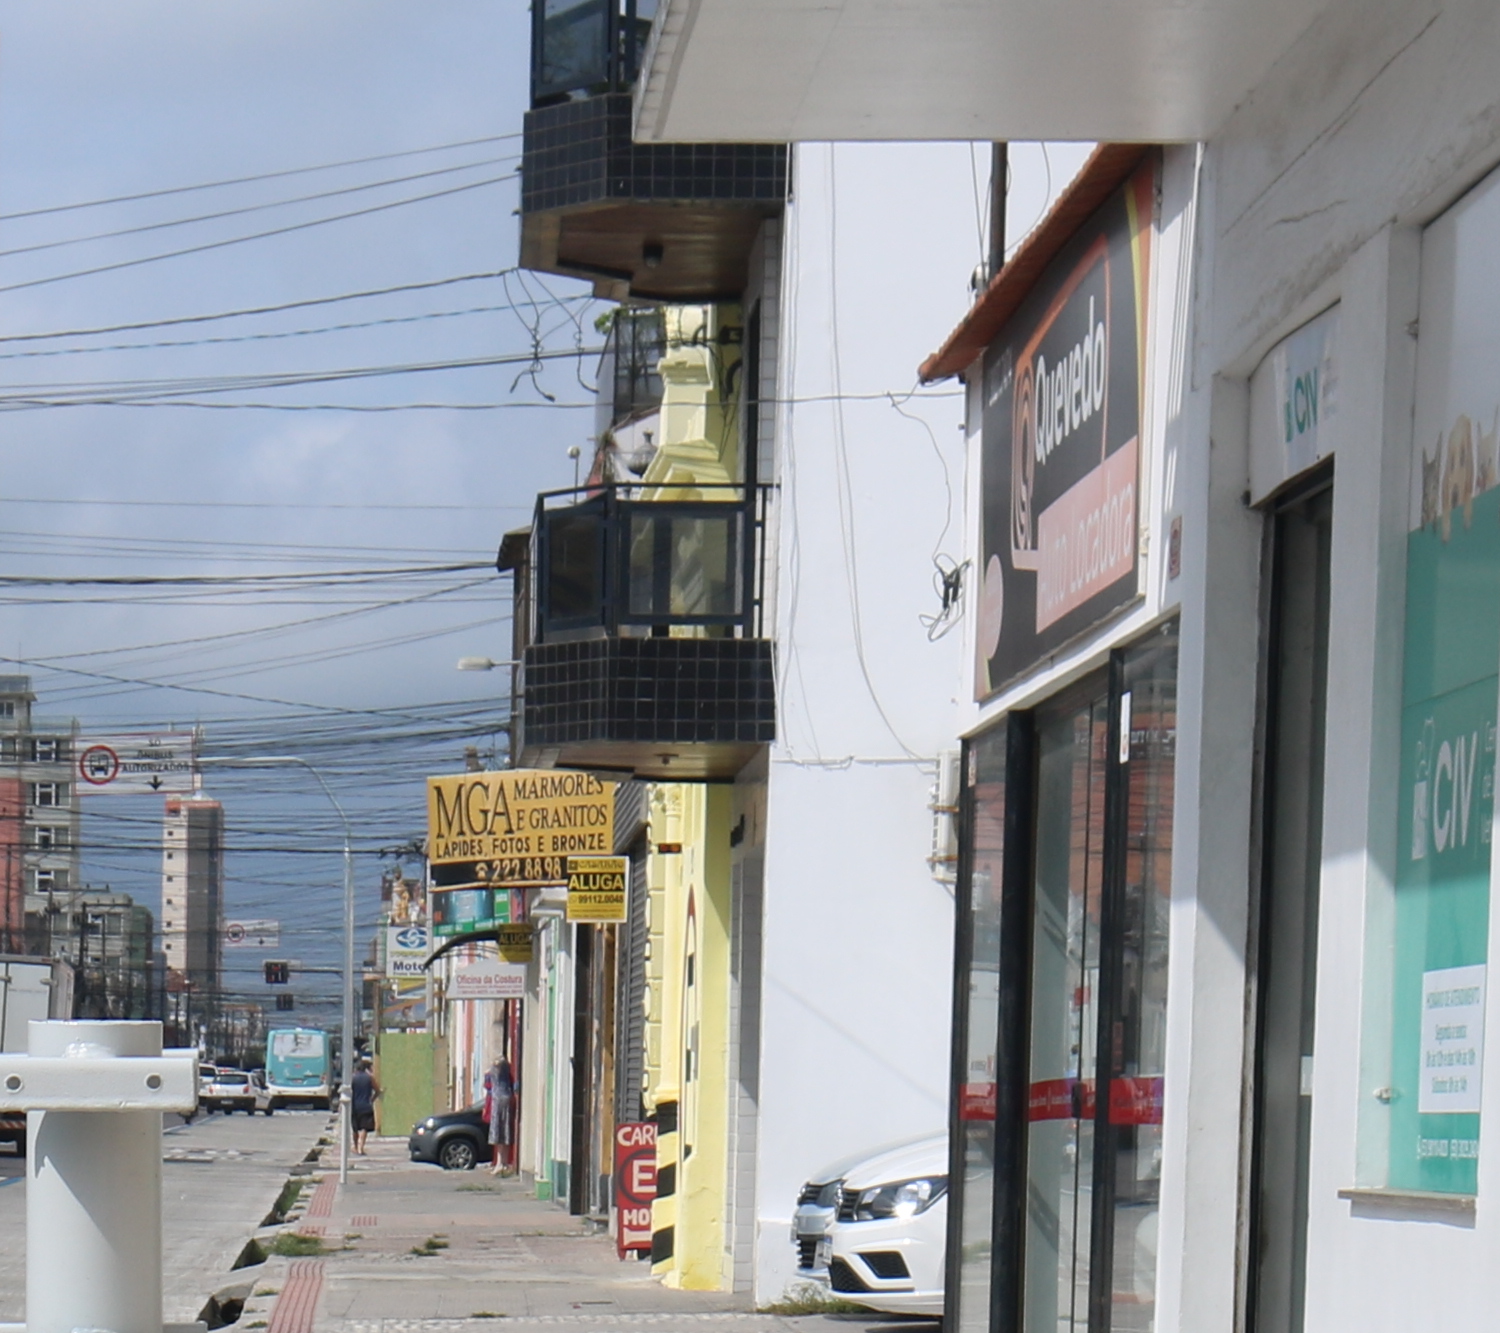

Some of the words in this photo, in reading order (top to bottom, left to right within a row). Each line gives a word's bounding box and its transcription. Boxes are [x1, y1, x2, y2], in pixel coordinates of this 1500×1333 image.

[1034, 295, 1105, 465] Quevedo
[1039, 535, 1067, 614] Auto
[1070, 472, 1133, 593] Locadora
[1433, 731, 1478, 853] CIV
[434, 781, 515, 839] MGA
[517, 809, 525, 831] E
[529, 804, 608, 830] GRANITOS
[492, 837, 531, 854] FOTOS
[538, 836, 544, 852] E
[568, 875, 625, 890] ALUGA
[500, 933, 531, 944] ALUGA
[393, 961, 431, 971] Moto
[456, 975, 482, 984] Oficina
[483, 975, 493, 984] da
[494, 974, 523, 984] Costura
[632, 1159, 657, 1194] E
[623, 1208, 653, 1226] MO
